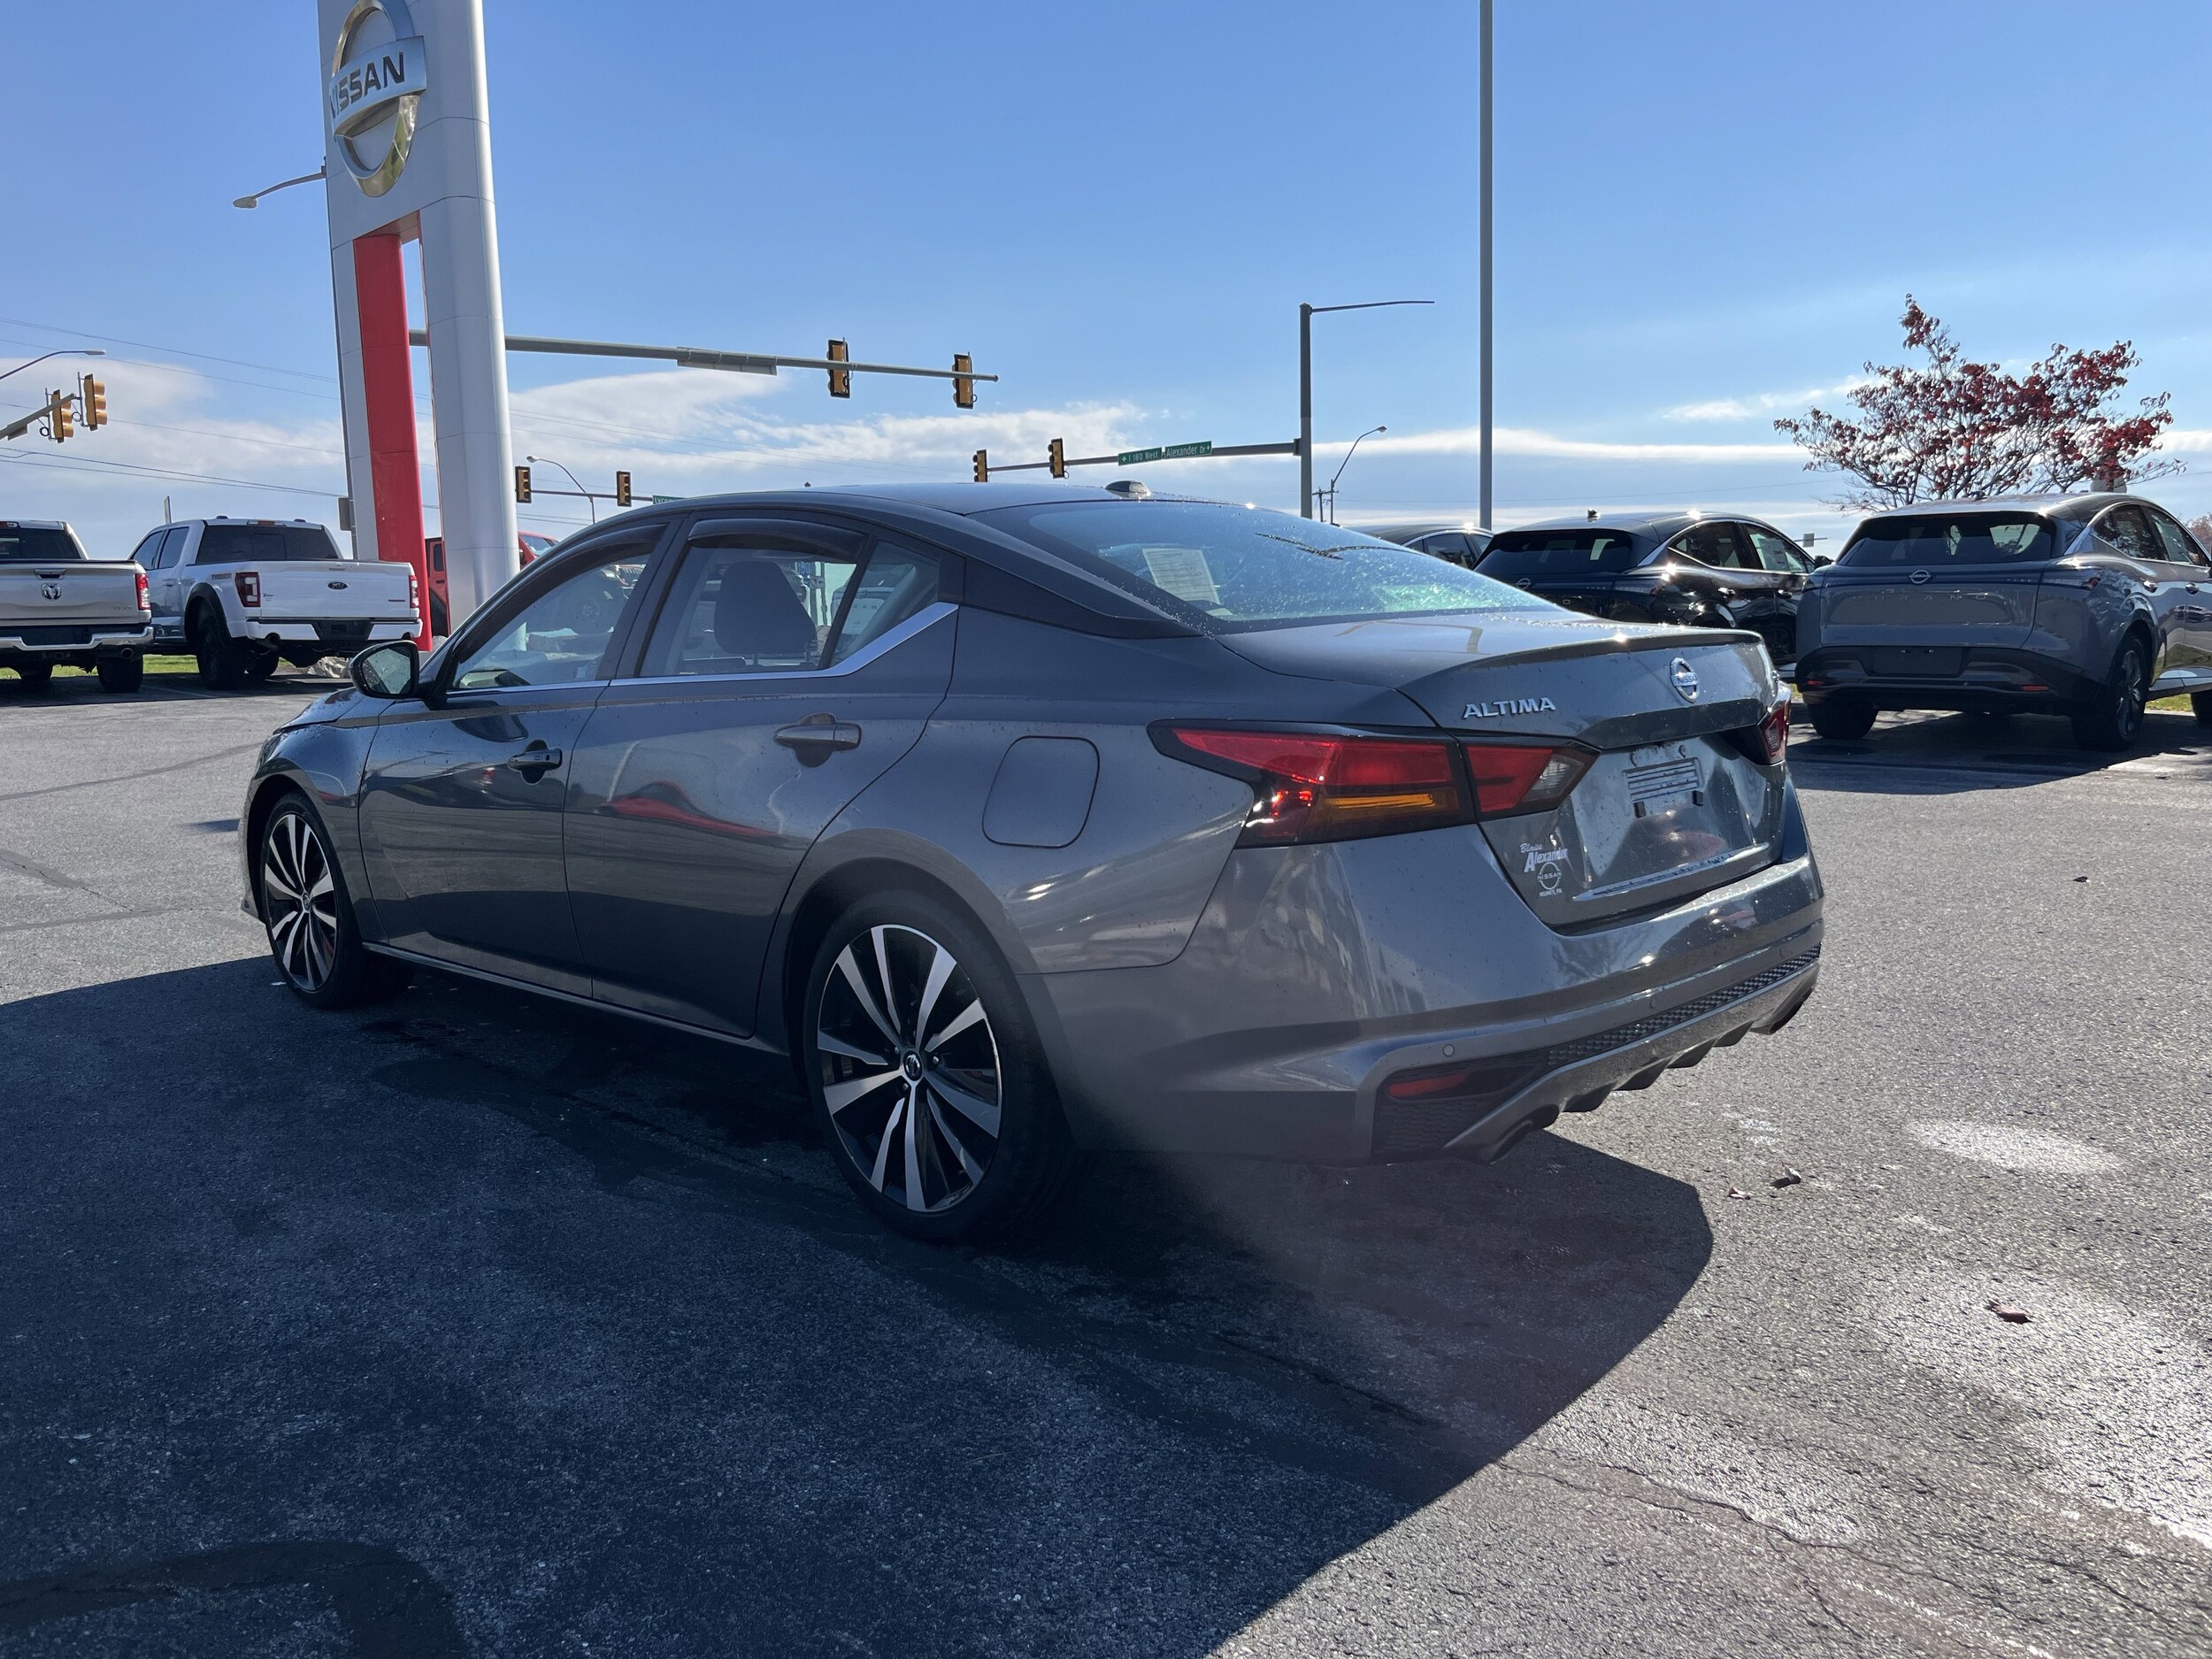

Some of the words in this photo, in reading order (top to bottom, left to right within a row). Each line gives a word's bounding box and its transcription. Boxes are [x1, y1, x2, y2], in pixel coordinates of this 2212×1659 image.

[1133, 453, 1143, 462] 180
[1145, 451, 1158, 460] West
[1166, 445, 1198, 457] Alexander
[1200, 445, 1205, 454] Dr
[1462, 697, 1556, 719] ALTIMA
[1524, 847, 1568, 872] Alexander
[1537, 870, 1562, 881] NISSAN
